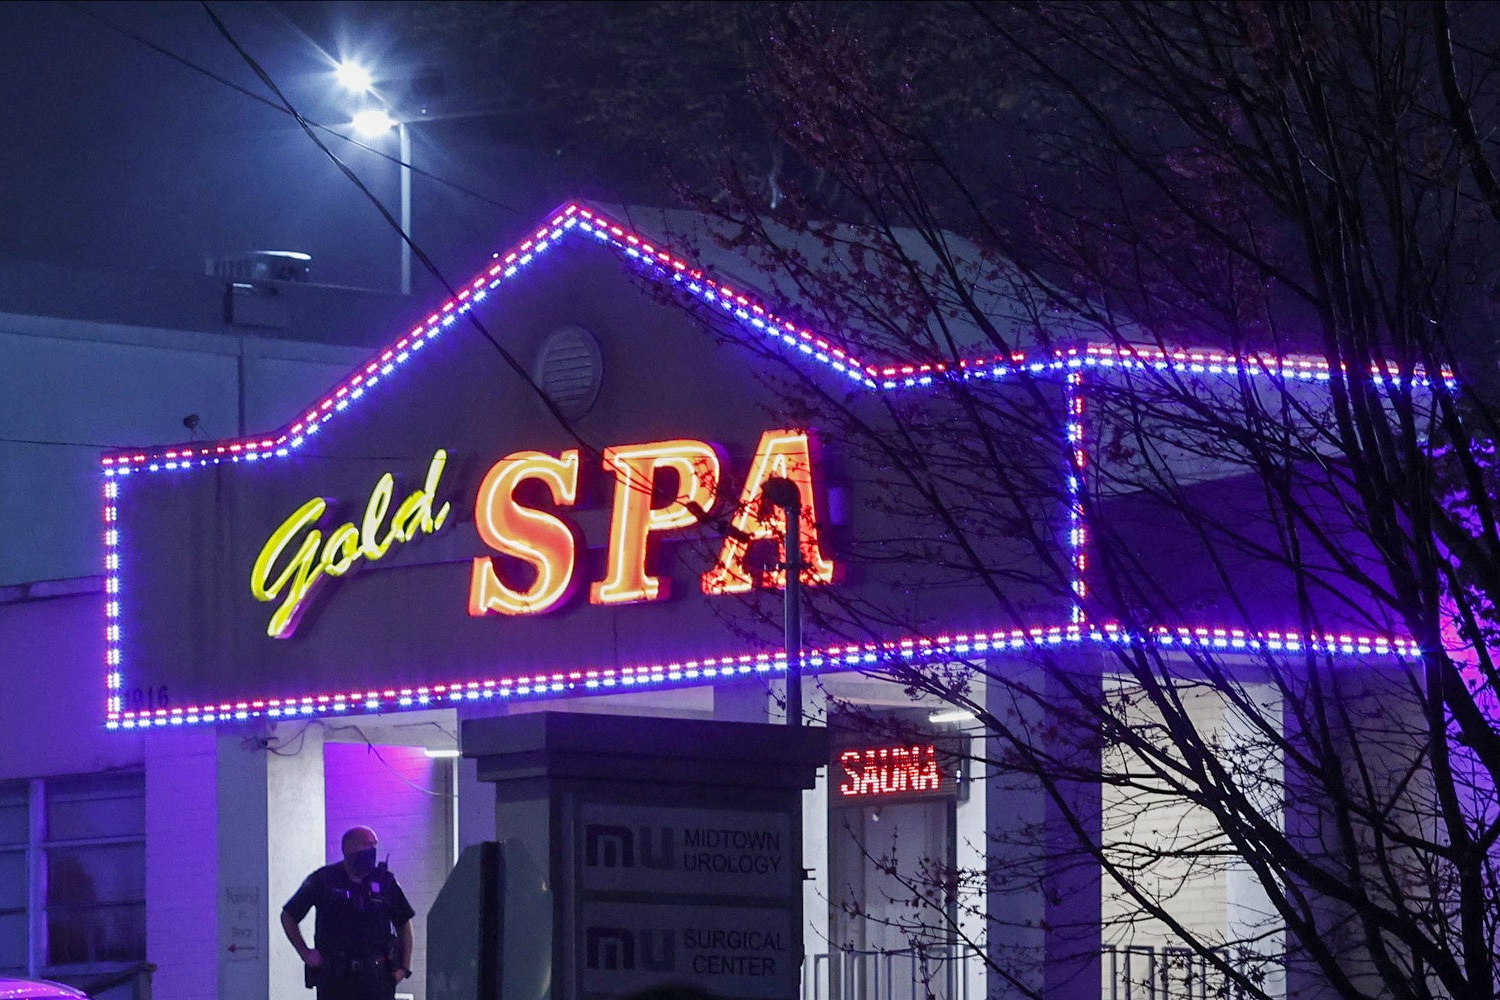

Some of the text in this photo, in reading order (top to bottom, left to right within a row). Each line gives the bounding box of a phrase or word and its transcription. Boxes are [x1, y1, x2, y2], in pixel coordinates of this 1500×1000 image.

[250, 428, 834, 638] Gold SPA
[840, 746, 939, 795] SAUNA
[684, 828, 781, 851] MIDTOWN
[684, 853, 782, 875] UROLOGY
[684, 928, 786, 952] SURGICAL
[692, 954, 776, 977] CENTER
